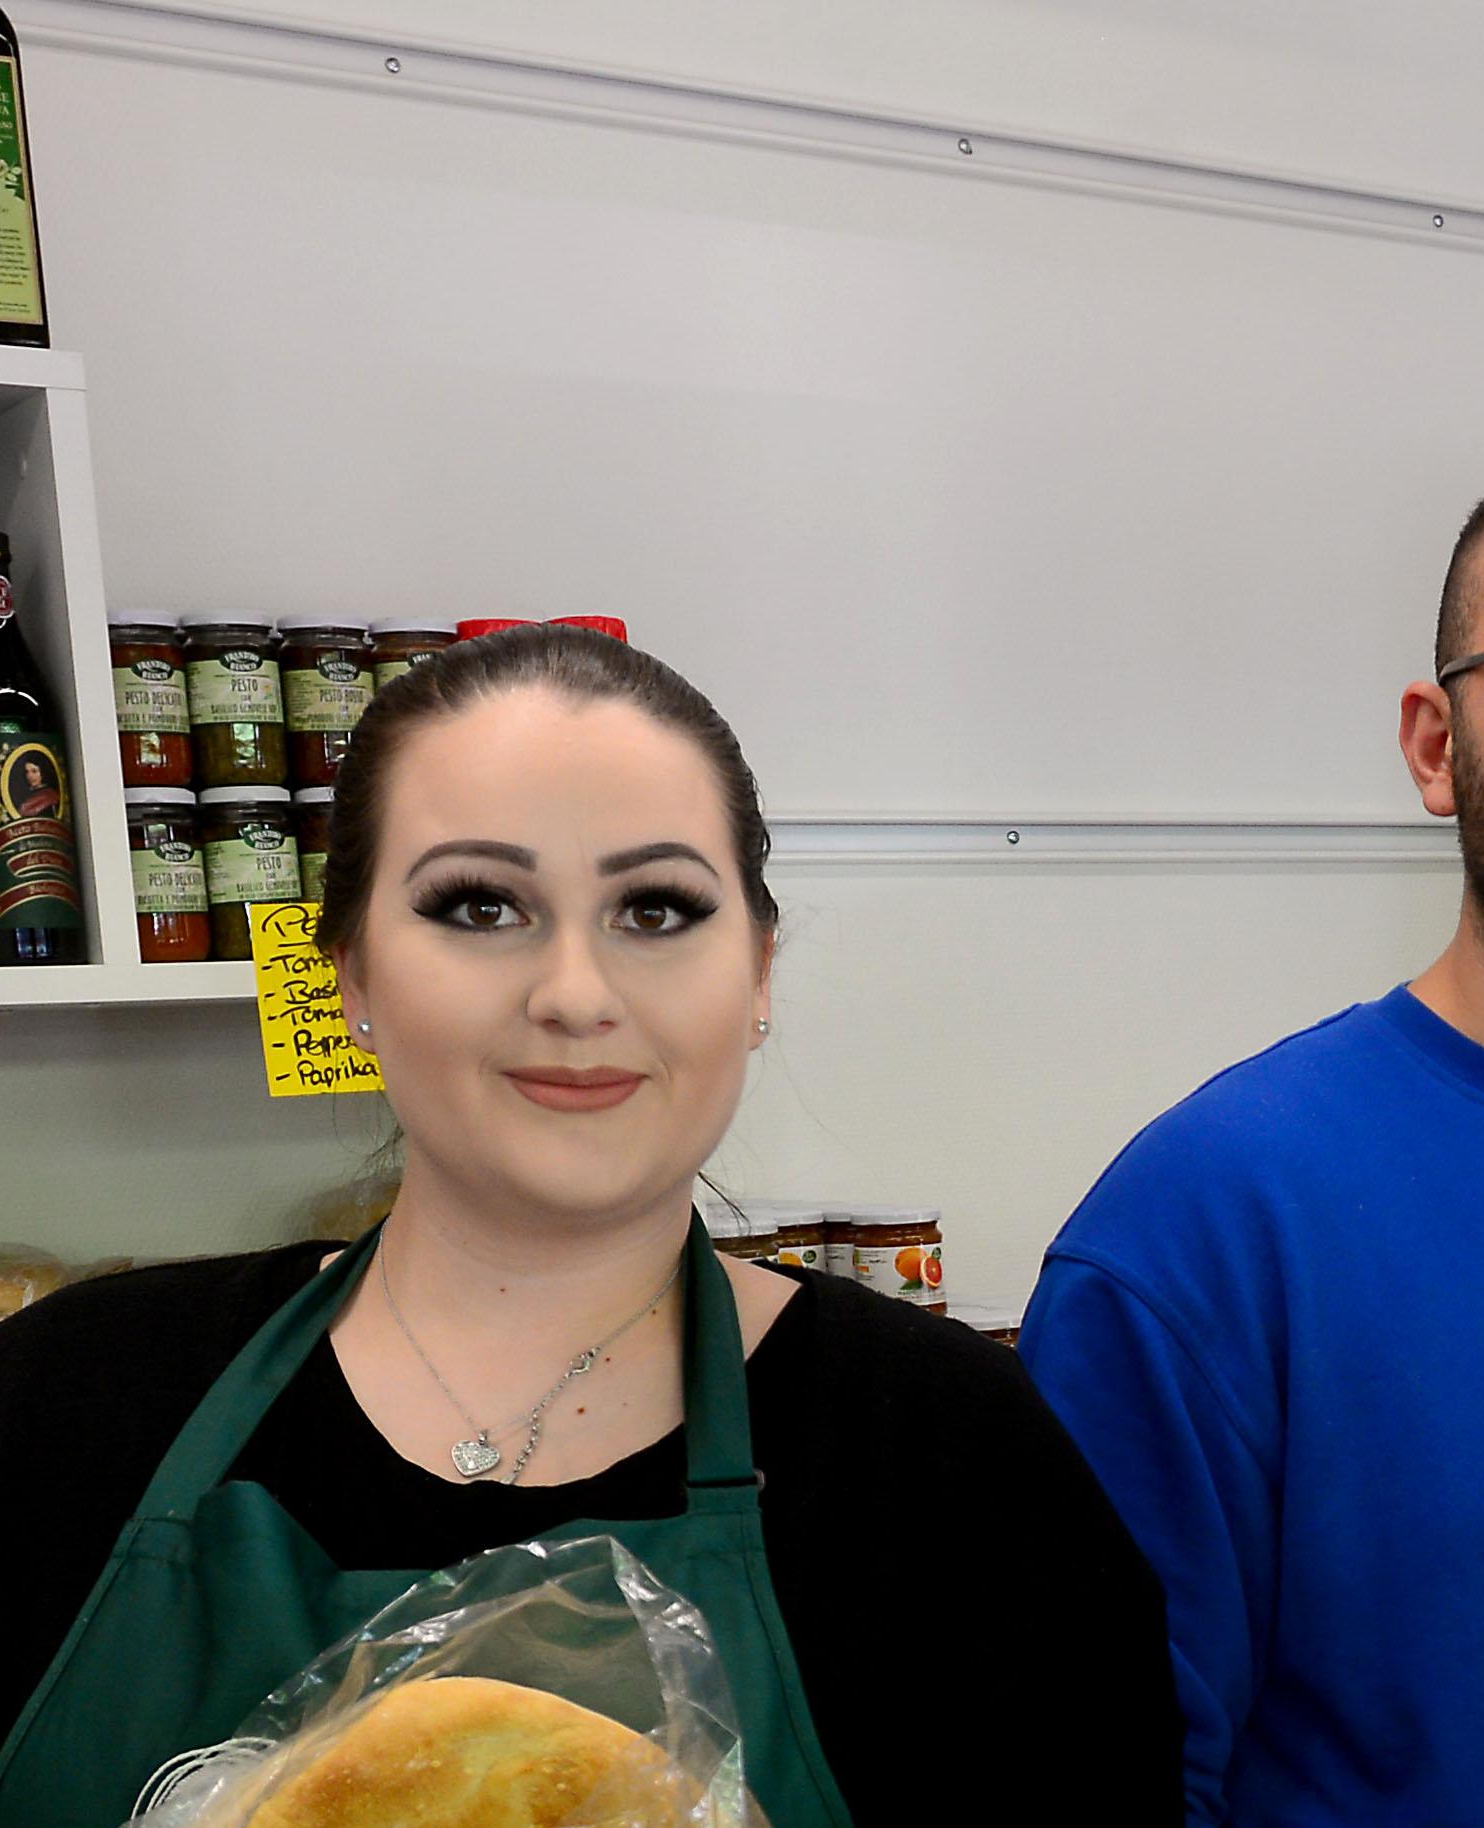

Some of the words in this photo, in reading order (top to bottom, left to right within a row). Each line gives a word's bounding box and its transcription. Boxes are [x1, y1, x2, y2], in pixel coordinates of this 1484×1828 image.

[231, 678, 259, 692] PESTO
[125, 690, 149, 705] PESTO
[256, 856, 282, 870] PESTO
[148, 873, 173, 887] PESTO
[262, 905, 317, 938] Pe
[279, 1006, 344, 1026] Toma
[296, 1055, 379, 1089] Paprika
